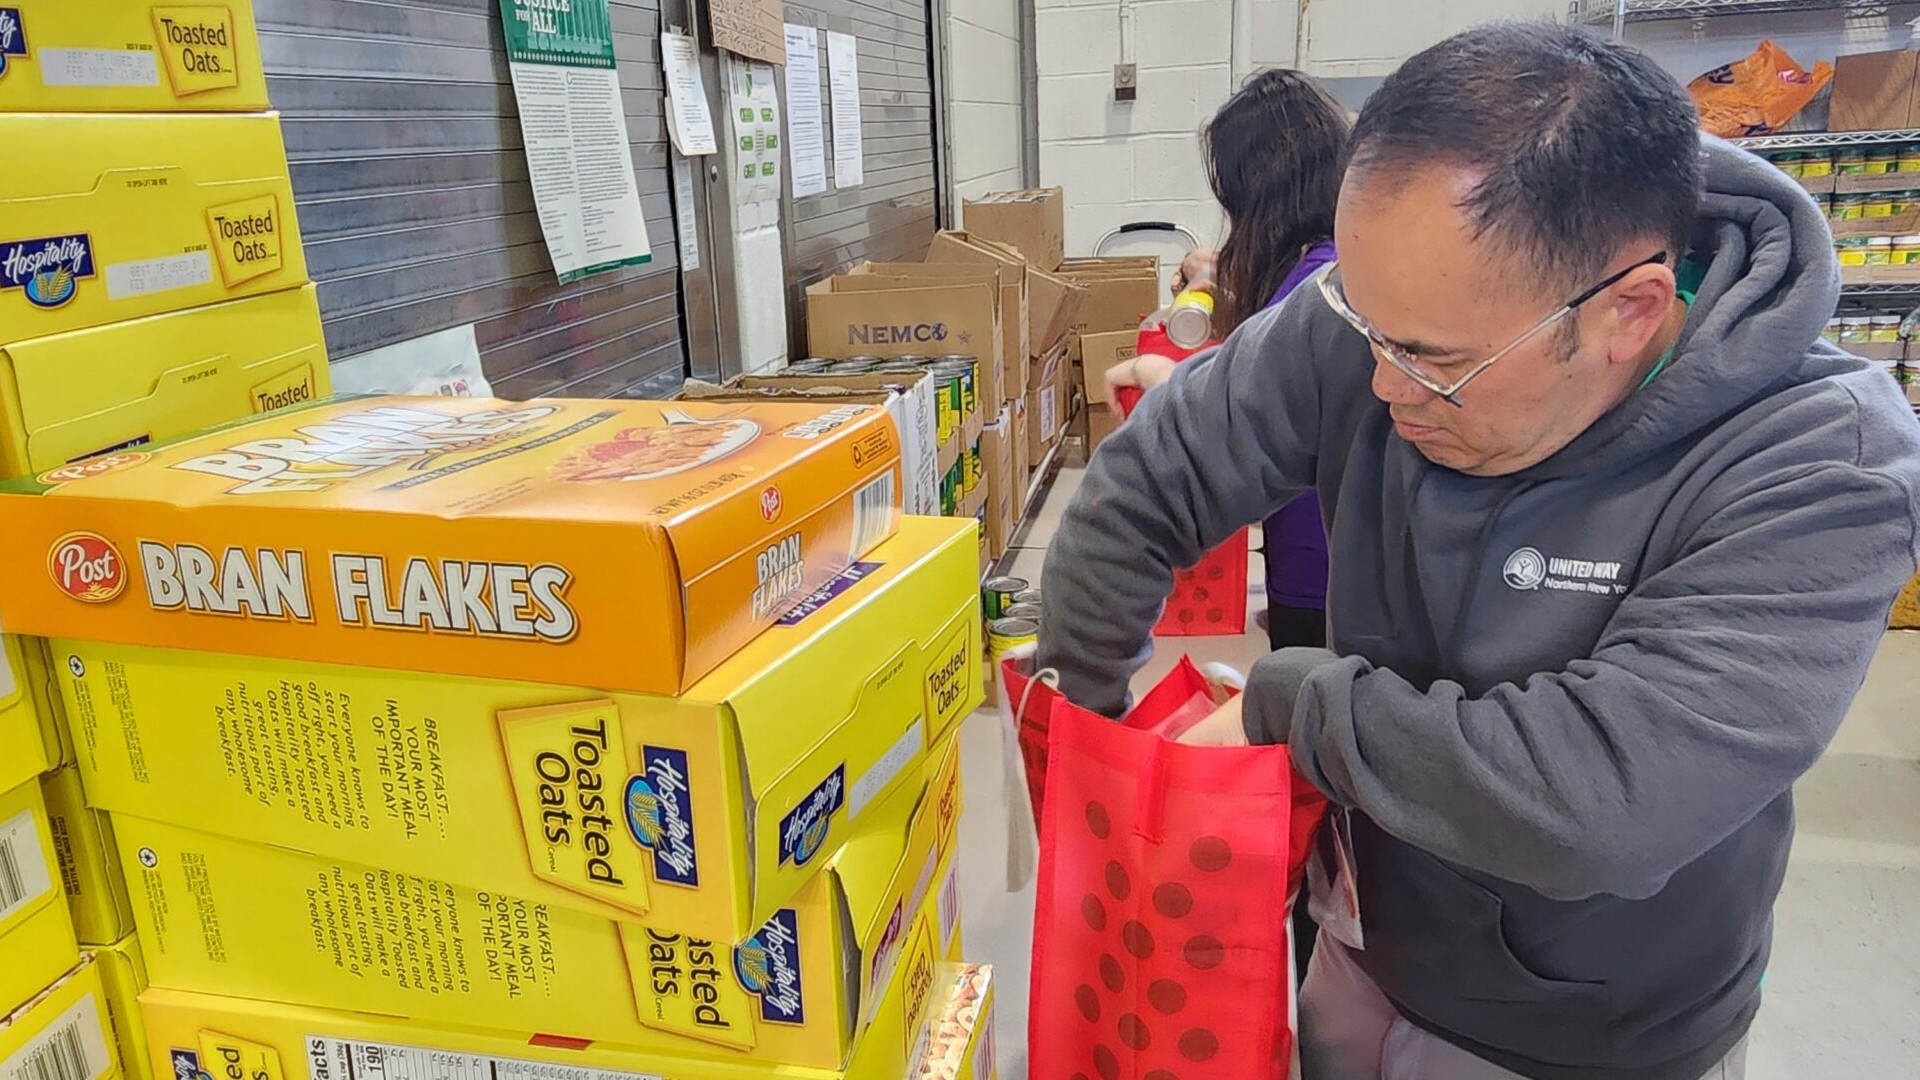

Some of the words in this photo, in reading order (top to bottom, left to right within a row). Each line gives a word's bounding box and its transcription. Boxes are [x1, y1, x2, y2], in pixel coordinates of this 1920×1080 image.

[160, 18, 226, 46] Toasted
[515, 9, 530, 21] FOR
[532, 11, 557, 34] ALL
[182, 48, 221, 73] Oats
[214, 210, 273, 240] Toasted
[2, 237, 86, 283] Hospitality
[233, 240, 267, 264] Oats
[257, 378, 309, 413] Toasted
[166, 406, 460, 483] BRAN
[224, 406, 557, 497] FLAKES
[55, 453, 135, 480] Post
[762, 490, 778, 518] Post
[58, 547, 116, 583] Post
[757, 532, 801, 586] BRAN
[1549, 557, 1593, 578] UNITED
[1593, 561, 1621, 580] WAY
[138, 539, 313, 621] BRAN
[331, 552, 578, 643] FLAKES
[751, 560, 804, 622] FLAKES
[1544, 577, 1586, 592] Northern
[1587, 581, 1610, 595] New
[929, 640, 966, 700] Toasted
[266, 689, 280, 723] Oats
[292, 683, 309, 720] good
[307, 681, 321, 705] off
[324, 690, 338, 728] start
[937, 680, 960, 715] Oats
[215, 705, 237, 777] breakfast.
[225, 688, 237, 715] any
[231, 719, 253, 795] wholesome
[238, 681, 257, 753] nutritious
[249, 755, 266, 788] part
[259, 790, 271, 807] of
[273, 728, 287, 754] will
[312, 706, 326, 748] right,
[371, 716, 386, 740] OF
[252, 700, 269, 740] great
[262, 744, 279, 797] tasting,
[279, 680, 300, 762] Hospitality
[294, 767, 315, 822] Toasted
[300, 723, 321, 794] breakfast
[318, 752, 332, 780] you
[328, 731, 343, 766] your
[339, 692, 358, 763] Everyone
[351, 766, 365, 811] knows
[360, 815, 370, 830] to
[376, 745, 392, 777] THE
[406, 726, 423, 772] YOUR
[279, 758, 293, 796] make
[385, 699, 411, 795] IMPORTANT
[400, 796, 418, 840] MEAL
[288, 799, 296, 808] a
[314, 797, 329, 824] and
[326, 783, 341, 819] need
[337, 769, 355, 828] morning
[382, 781, 399, 818] DAY!
[413, 776, 432, 823] MOST
[534, 751, 571, 847] Oats
[571, 719, 625, 889] Toasted
[652, 756, 693, 878] Hospitality
[784, 772, 843, 852] Hospitality
[333, 820, 341, 830] a
[547, 846, 558, 874] Cereal
[332, 865, 351, 930] nutritious
[364, 872, 377, 903] Oats
[395, 873, 409, 899] ood
[412, 885, 428, 923] right,
[477, 891, 492, 912] OF
[306, 888, 326, 953] breakfast.
[318, 872, 329, 897] any
[324, 899, 344, 968] wholesome
[348, 882, 365, 918] great
[357, 920, 374, 968] tasting,
[370, 906, 385, 931] will
[400, 901, 420, 964] breakfast
[430, 908, 446, 939] your
[482, 917, 496, 945] THE
[495, 895, 516, 960] PORTANT
[512, 899, 530, 939] YOUR
[342, 931, 358, 961] part
[375, 933, 389, 967] make
[417, 926, 432, 950] you
[453, 936, 467, 976] knows
[349, 962, 363, 978] of
[381, 968, 391, 977] a
[391, 940, 411, 990] Toasted
[411, 966, 425, 991] and
[424, 953, 441, 985] need
[437, 940, 455, 991] morning
[486, 949, 503, 981] DAY!
[504, 961, 522, 999] MEAL
[518, 943, 537, 984] MOST
[687, 936, 731, 1028] asted
[762, 915, 801, 1017] Hospitality
[431, 986, 440, 995] a
[459, 979, 470, 993] to
[310, 1039, 329, 1080] acts
[365, 1046, 382, 1073] 190
